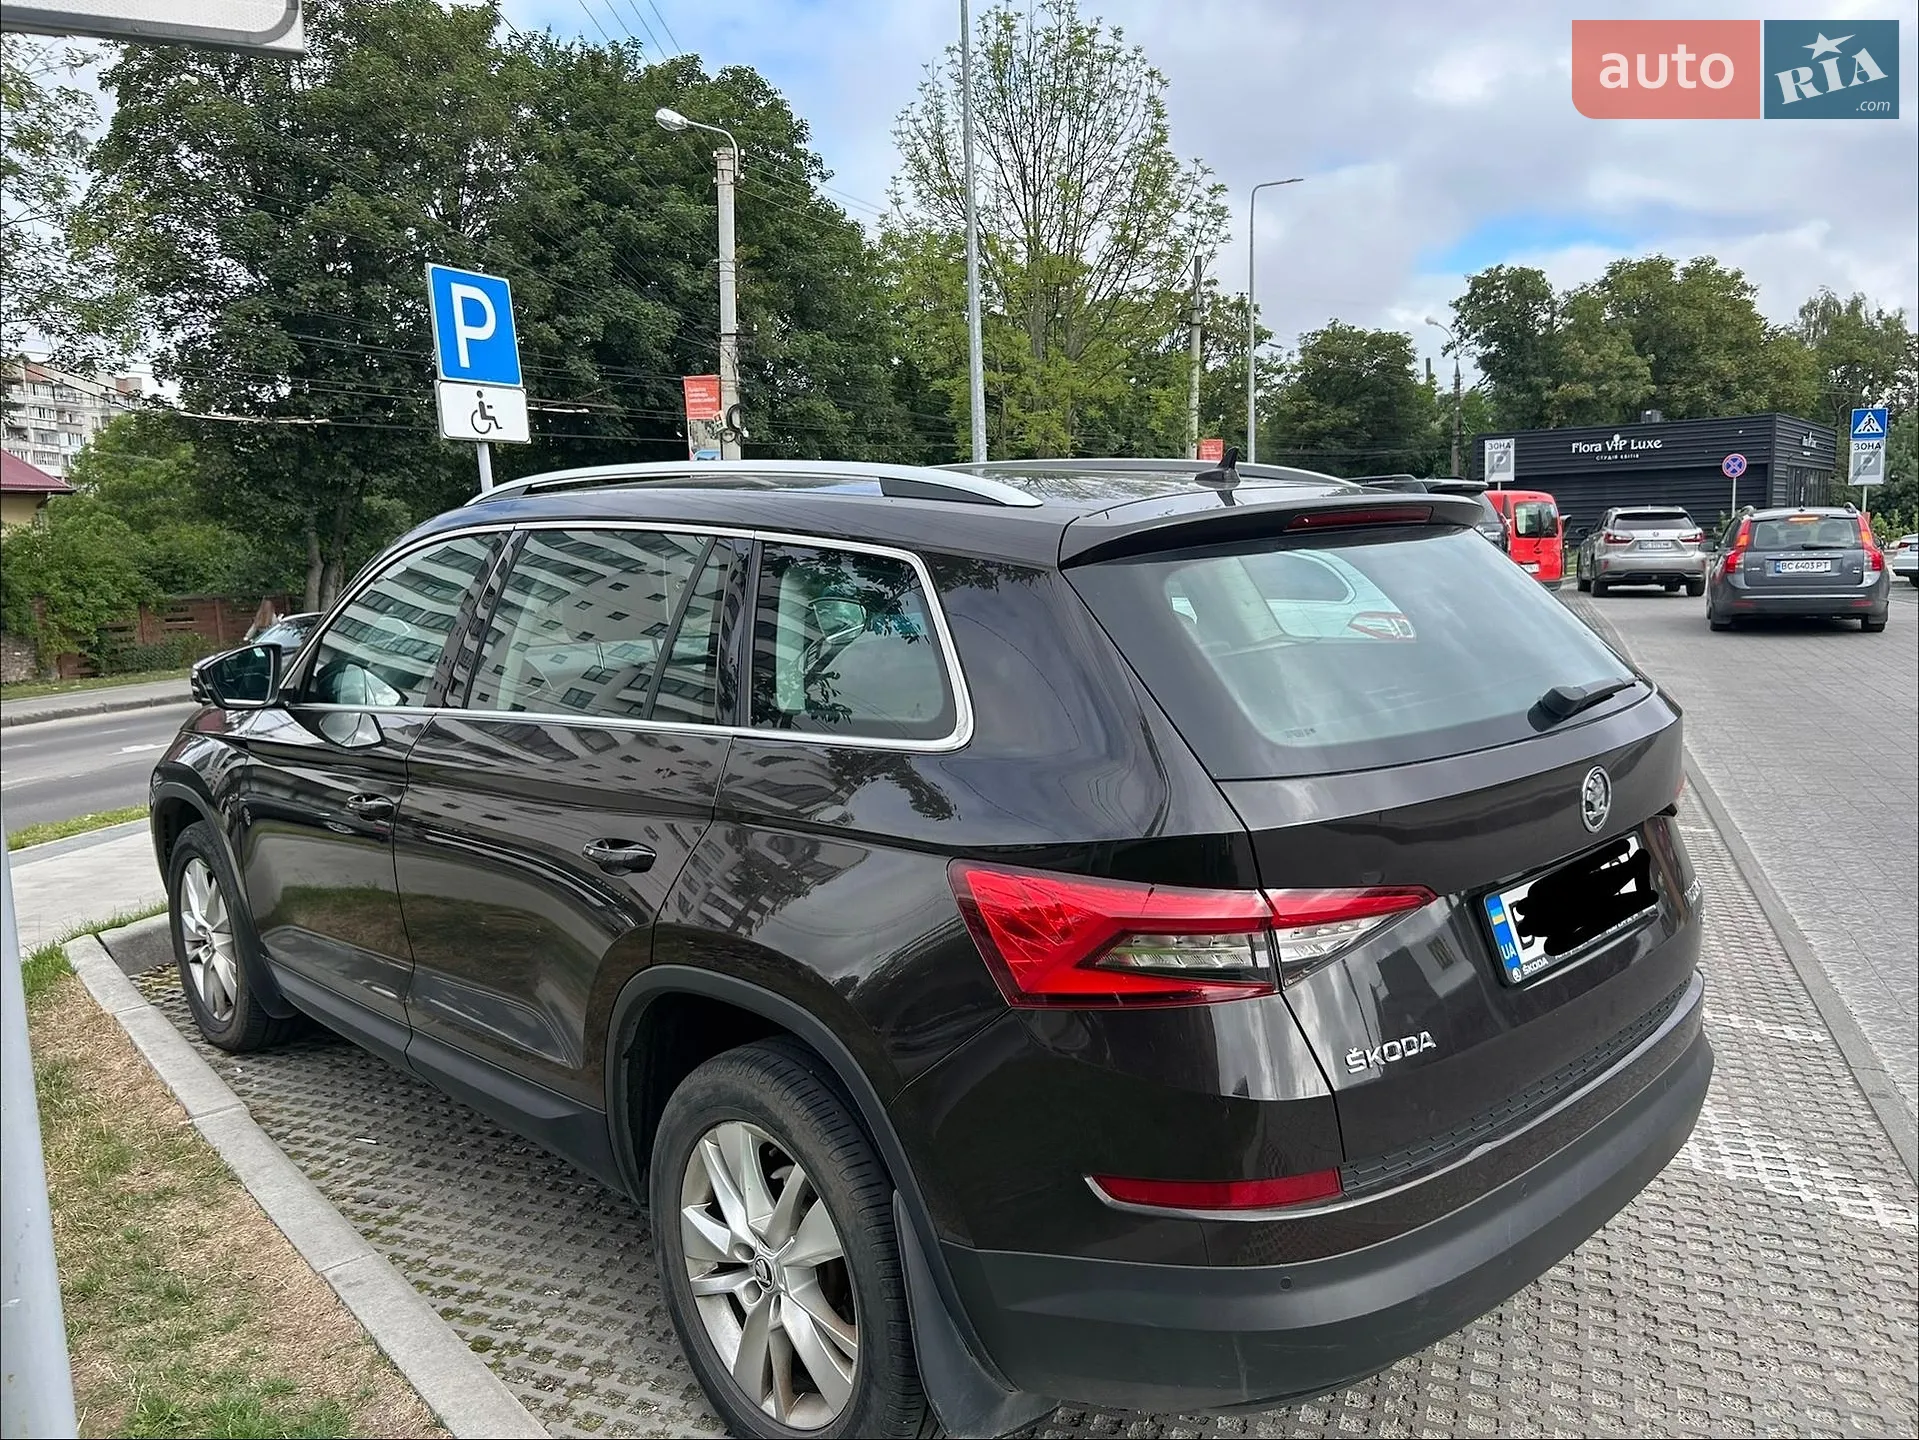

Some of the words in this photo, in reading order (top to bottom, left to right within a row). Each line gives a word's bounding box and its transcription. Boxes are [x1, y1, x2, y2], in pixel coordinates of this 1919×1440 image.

[450, 281, 497, 369] P
[1488, 442, 1511, 451] ЗОНА
[1571, 442, 1602, 453] Flora
[1630, 439, 1663, 450] Luxe
[1854, 442, 1881, 451] ЗОНА
[1781, 562, 1793, 570] BC
[1795, 561, 1815, 570] 6403
[1816, 561, 1829, 569] PT
[1501, 942, 1517, 960] UA
[1345, 1030, 1437, 1074] ŠKODA
